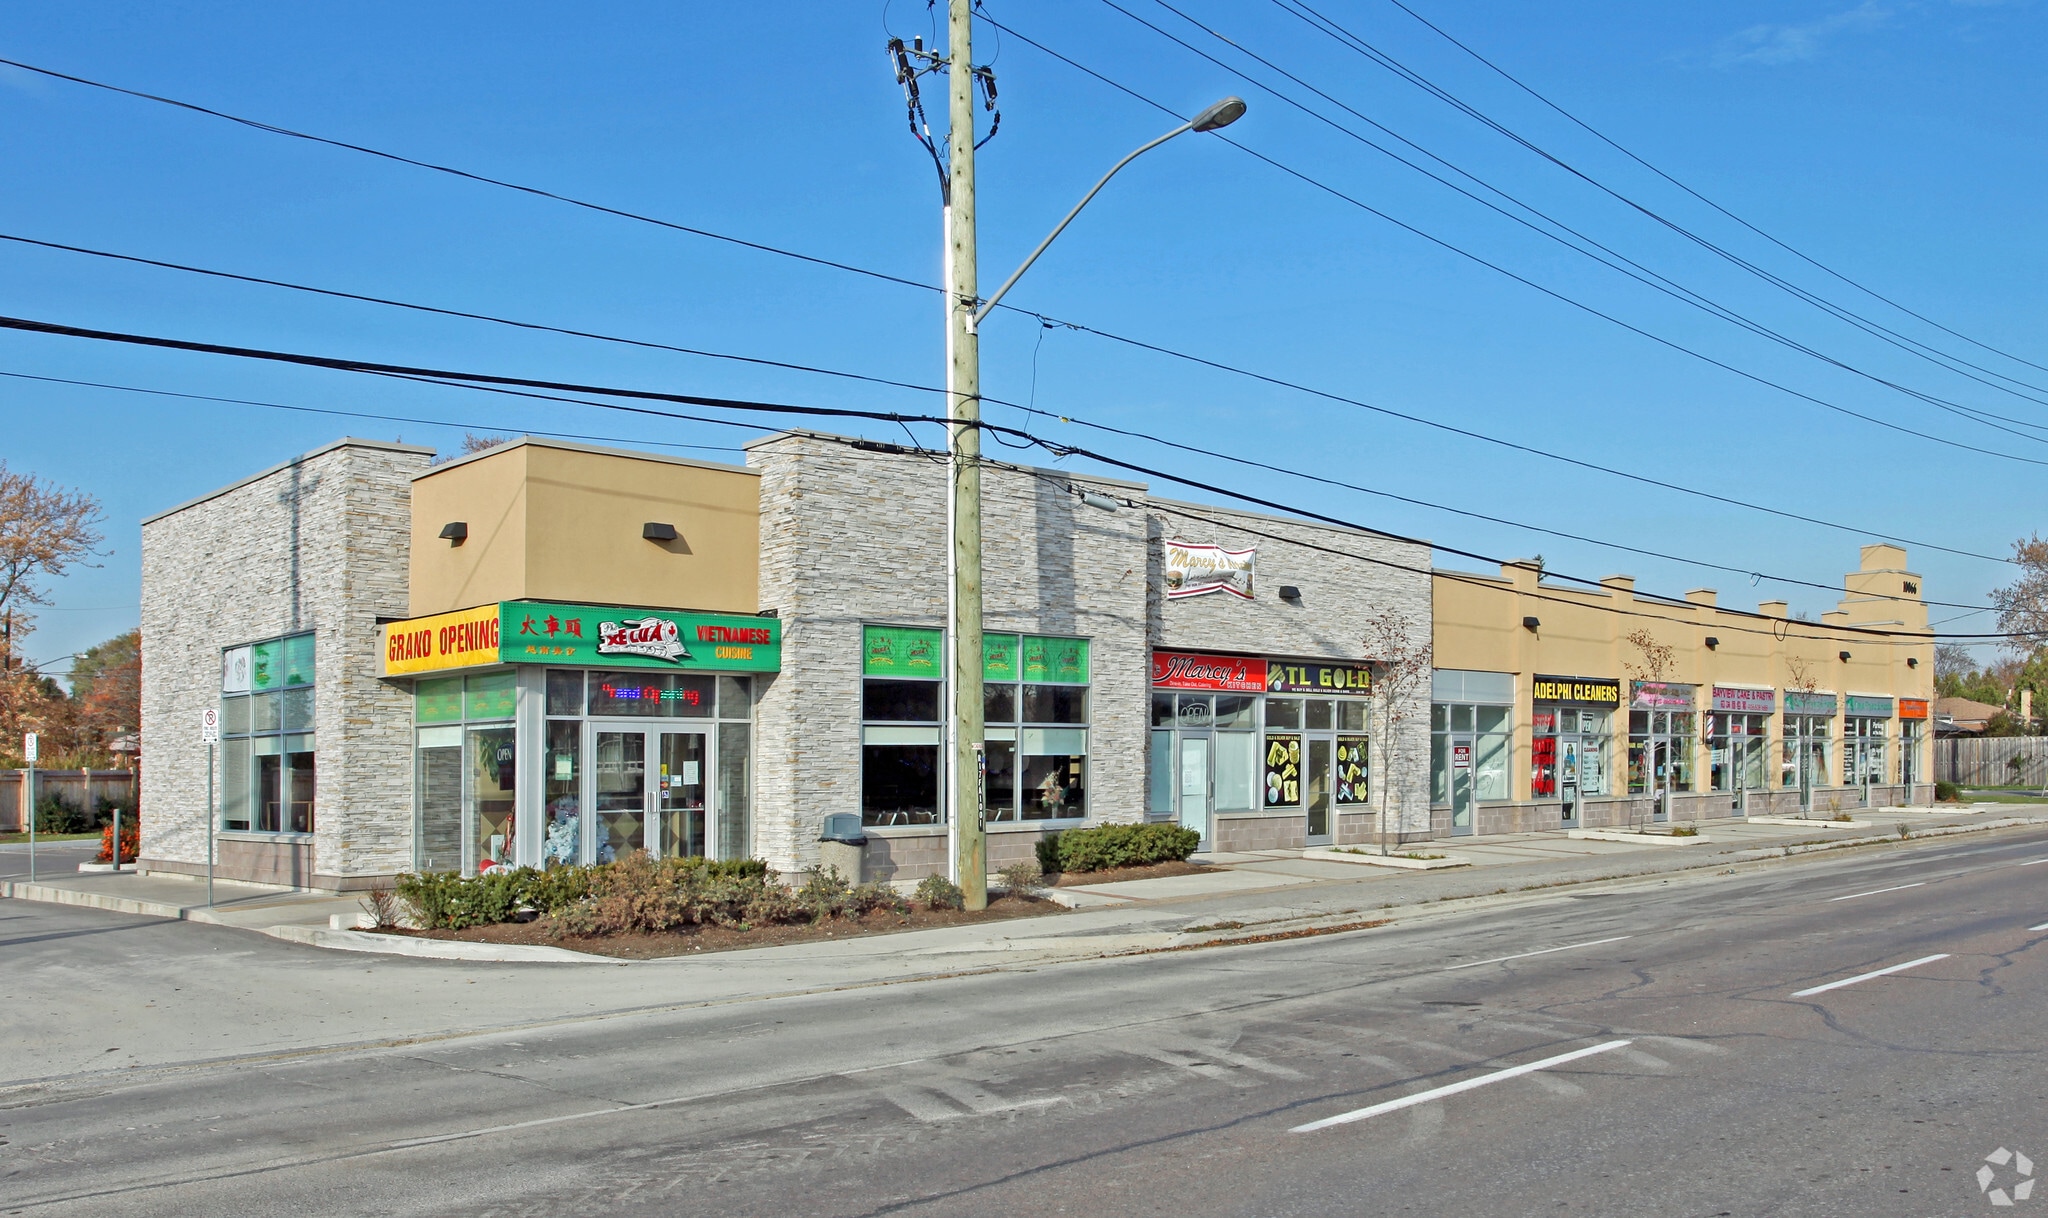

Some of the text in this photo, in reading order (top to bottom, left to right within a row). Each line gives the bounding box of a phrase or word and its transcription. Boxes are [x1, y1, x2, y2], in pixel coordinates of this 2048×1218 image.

[389, 617, 499, 662] GRAND OPENING
[607, 623, 663, 646] XE LUA
[696, 625, 771, 645] VIETNAMESE
[715, 646, 753, 660] CUISINE
[1153, 656, 1246, 686] Marcy's
[1319, 667, 1370, 689] GOLD
[1226, 681, 1262, 690] KITCHEN
[1534, 682, 1618, 702] ADELPHI CLEANERS
[496, 748, 513, 762] OPEN
